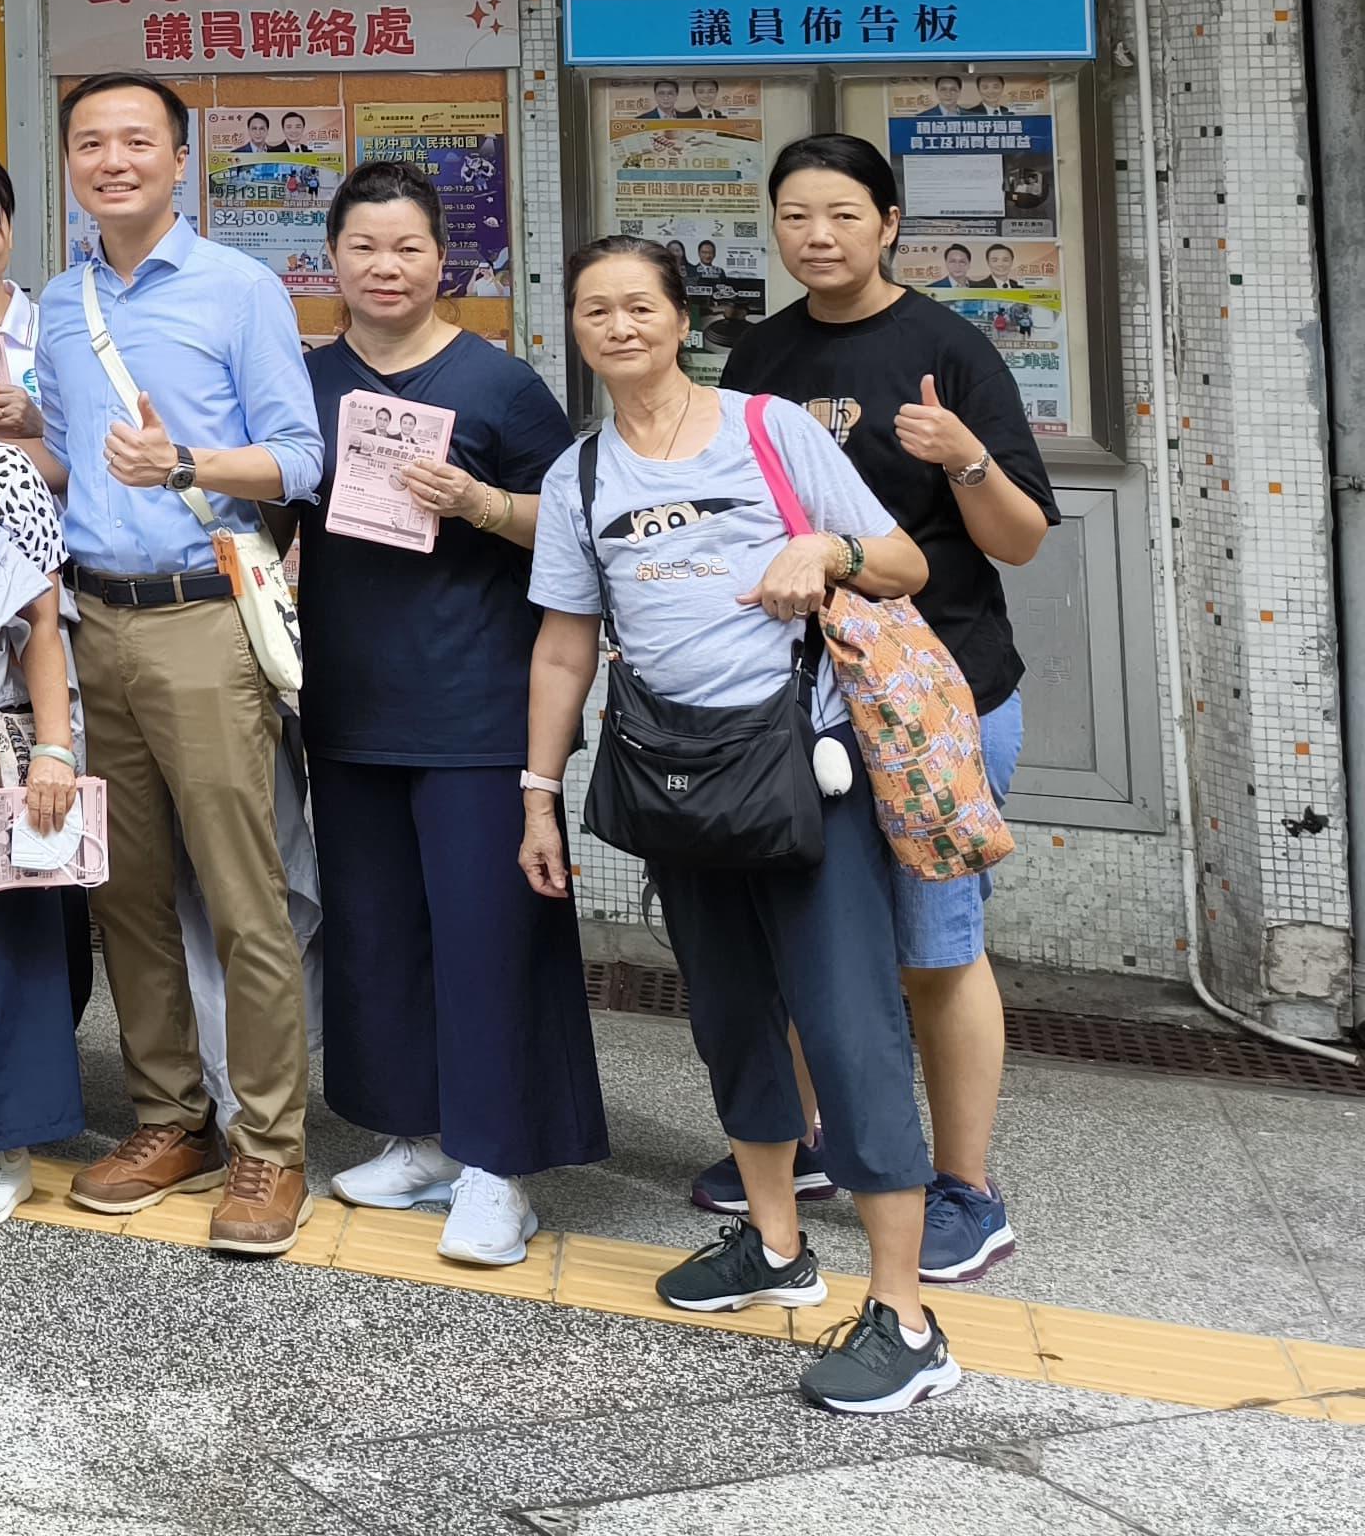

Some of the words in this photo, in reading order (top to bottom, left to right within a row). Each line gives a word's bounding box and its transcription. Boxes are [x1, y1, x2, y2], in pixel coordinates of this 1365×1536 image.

[143, 7, 415, 60] 議員聯絡處
[689, 4, 959, 47] 議員佈告板
